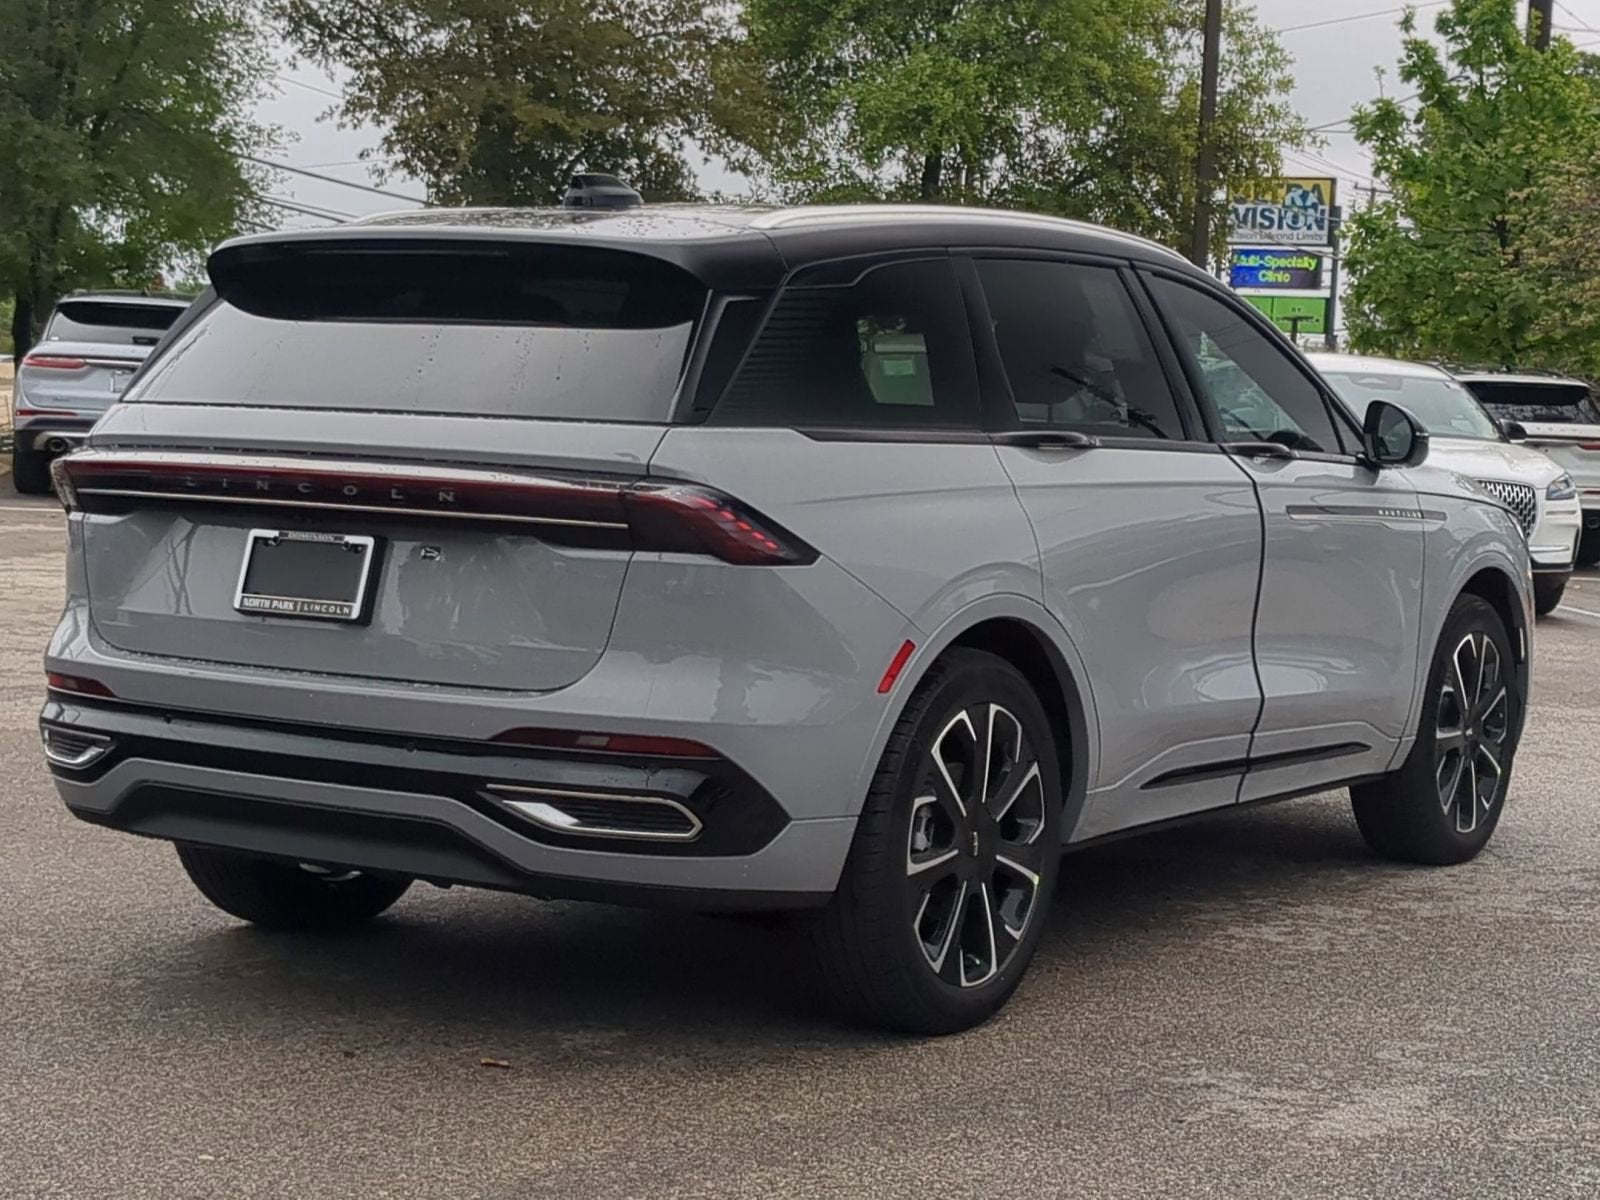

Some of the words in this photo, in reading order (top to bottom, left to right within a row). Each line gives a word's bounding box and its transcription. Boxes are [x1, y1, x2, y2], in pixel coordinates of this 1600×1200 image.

[1233, 207, 1325, 230] VISION
[1297, 231, 1323, 240] Limits
[186, 477, 455, 502] LINCOLN
[243, 598, 271, 608] NORTH
[272, 600, 295, 610] PARK
[304, 604, 350, 614] LINCOLN
